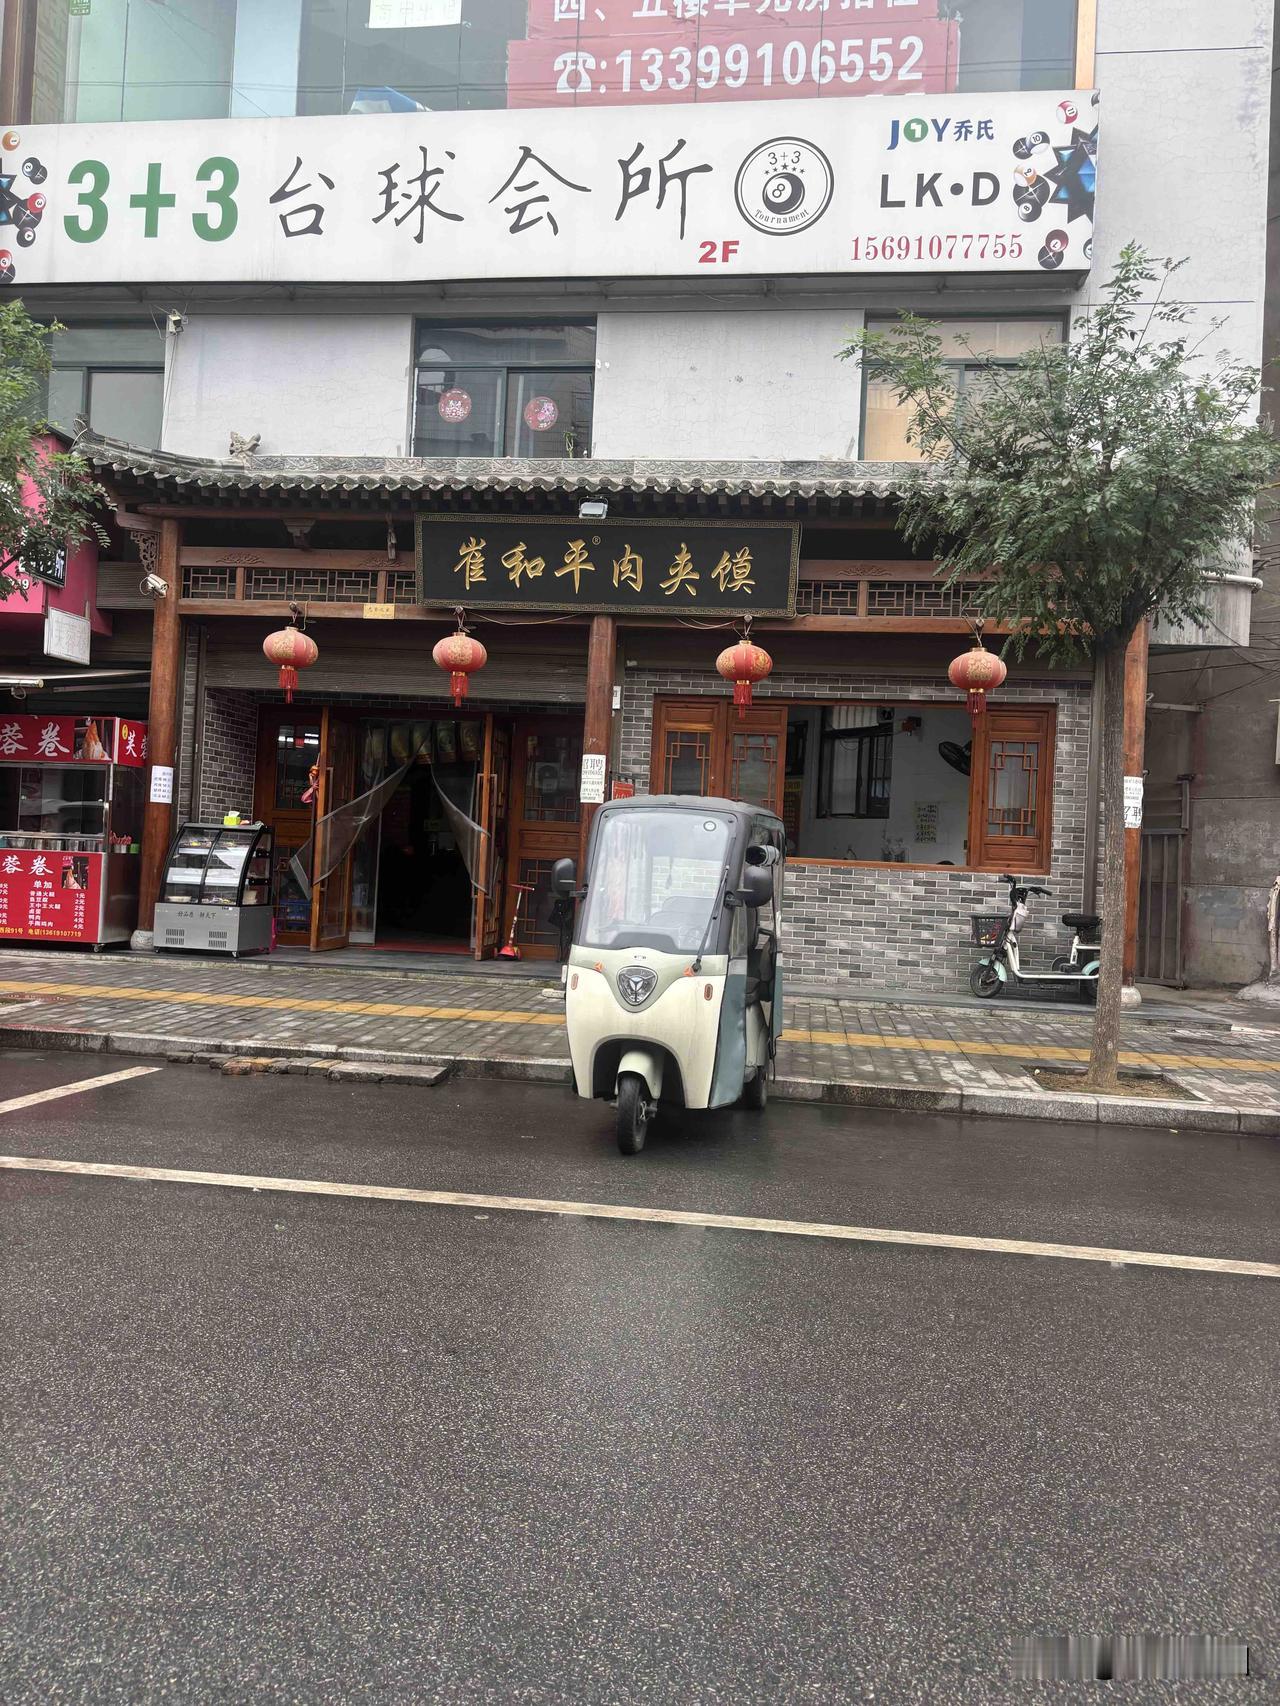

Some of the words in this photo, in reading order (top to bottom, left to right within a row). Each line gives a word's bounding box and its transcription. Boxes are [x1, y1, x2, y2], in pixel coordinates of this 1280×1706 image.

[953, 119, 995, 142] 乔氏
[767, 150, 802, 165] 3+3
[63, 156, 239, 244] 3+3
[268, 137, 714, 244] 台球会所
[771, 183, 786, 198] 8
[754, 208, 810, 224] Tournament
[698, 241, 740, 263] 2F
[851, 233, 1023, 261] 15691077755
